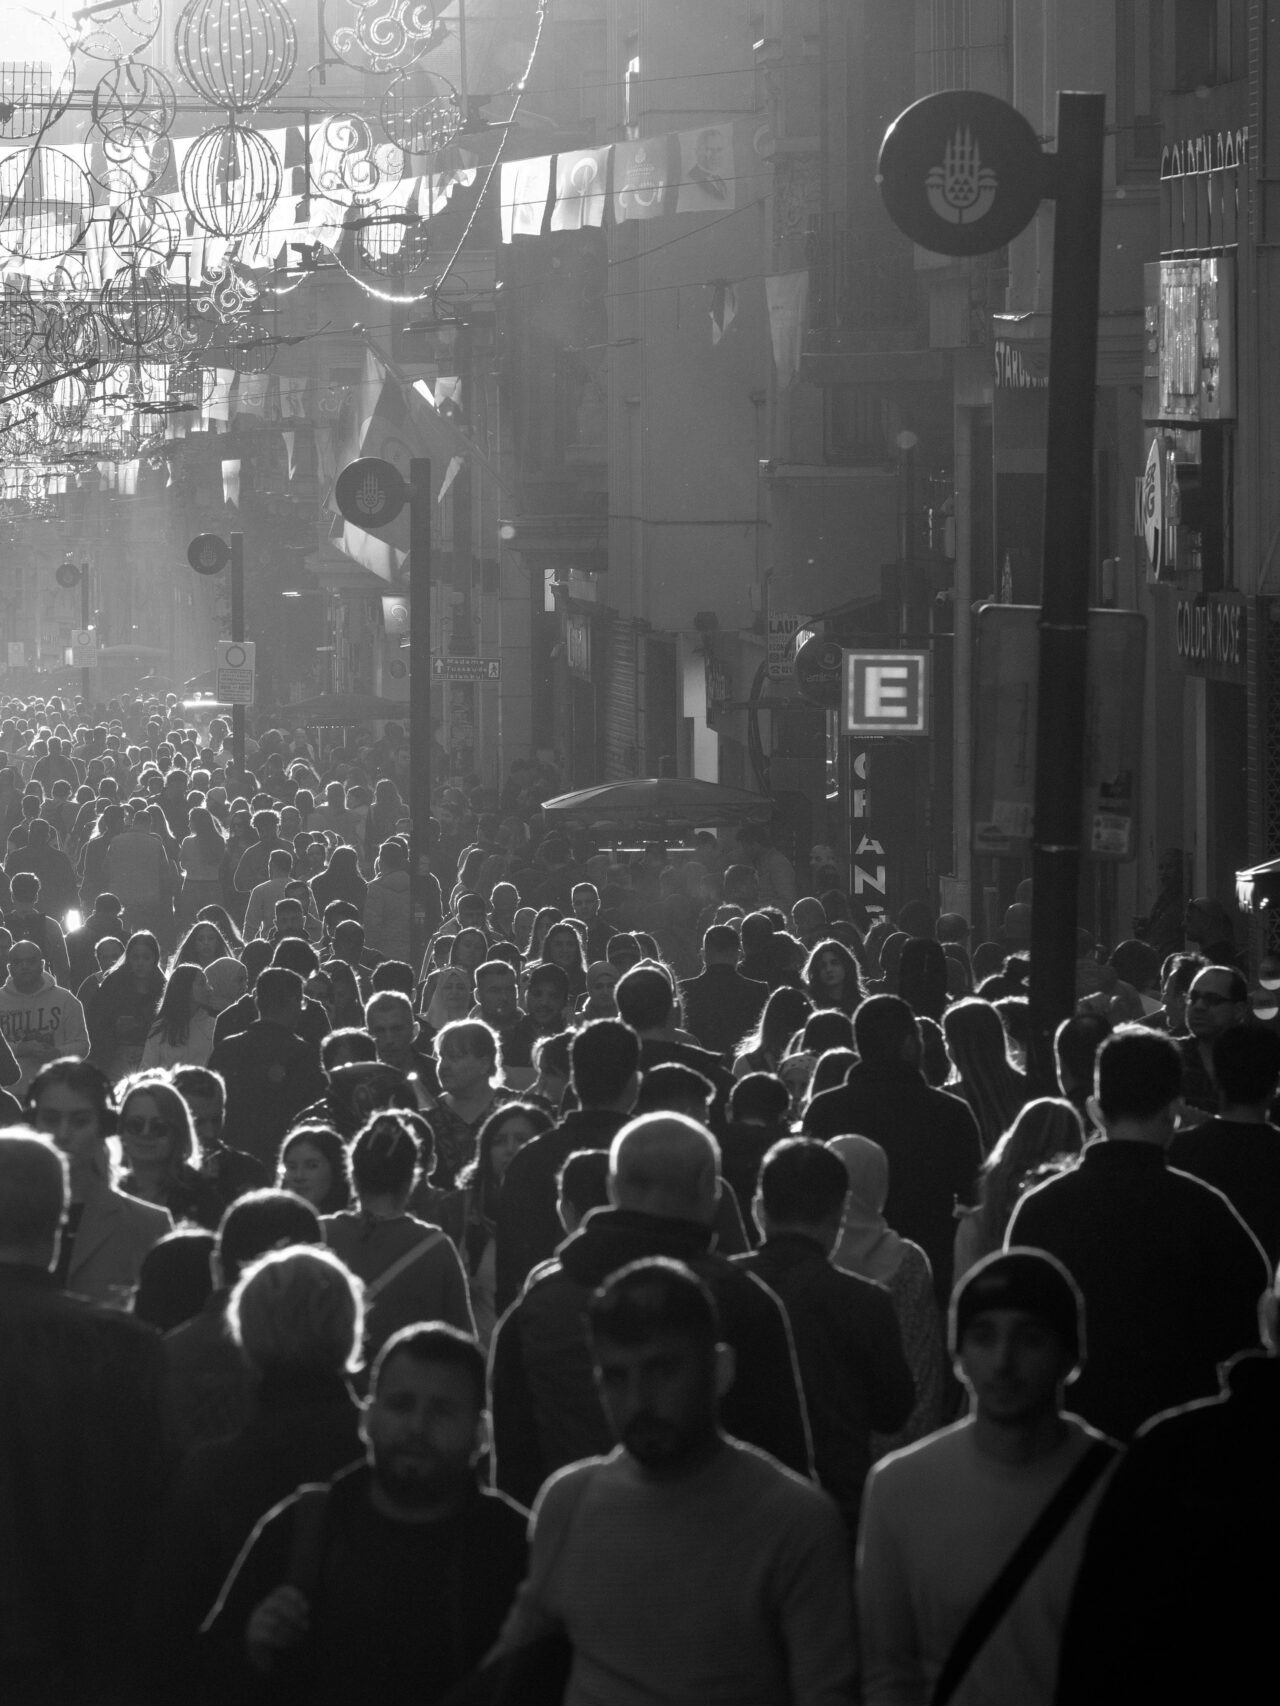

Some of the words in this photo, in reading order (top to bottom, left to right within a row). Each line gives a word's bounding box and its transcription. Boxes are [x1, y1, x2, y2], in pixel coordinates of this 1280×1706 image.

[1176, 600, 1213, 659] GOLDEN
[1216, 603, 1241, 664] ROSE
[864, 666, 908, 717] E
[0, 1006, 62, 1042] BULLS
